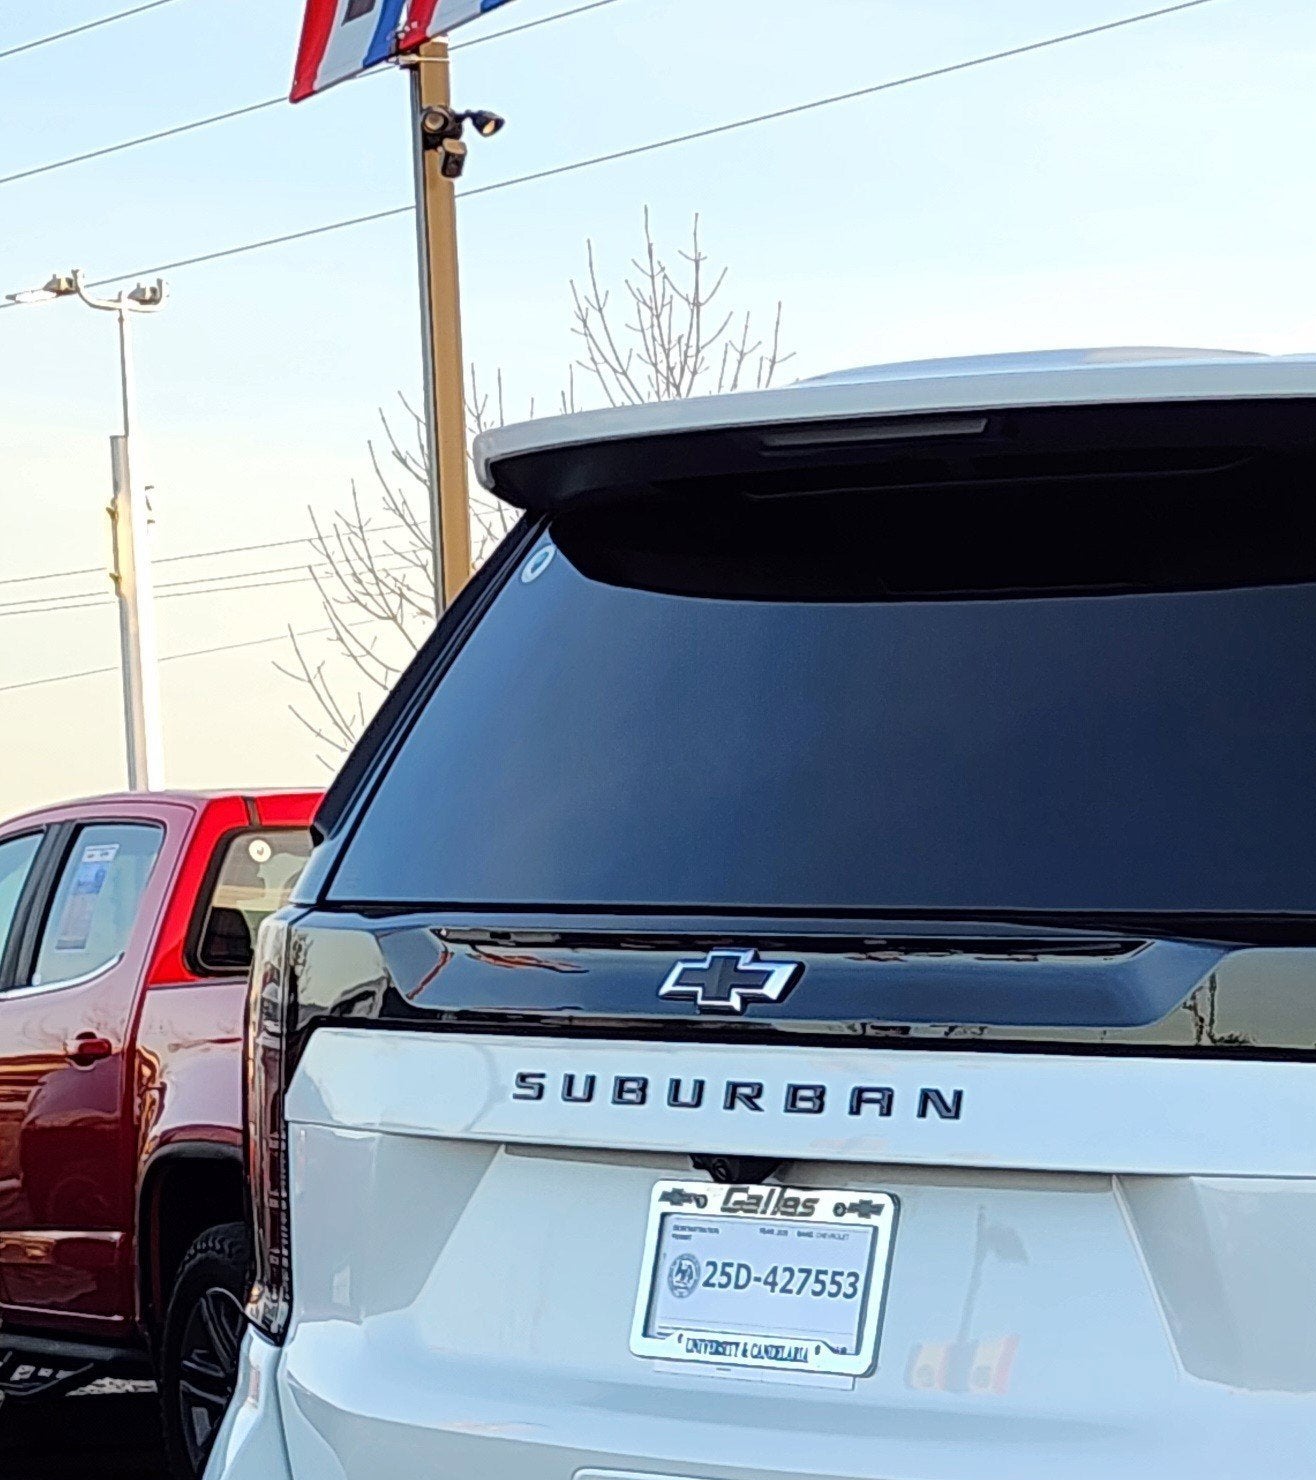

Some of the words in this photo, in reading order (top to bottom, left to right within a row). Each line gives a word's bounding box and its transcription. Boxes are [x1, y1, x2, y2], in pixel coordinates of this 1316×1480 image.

[512, 1071, 964, 1121] SUBURBAN
[720, 1186, 821, 1218] Galles
[701, 1260, 860, 1300] 25D-427553
